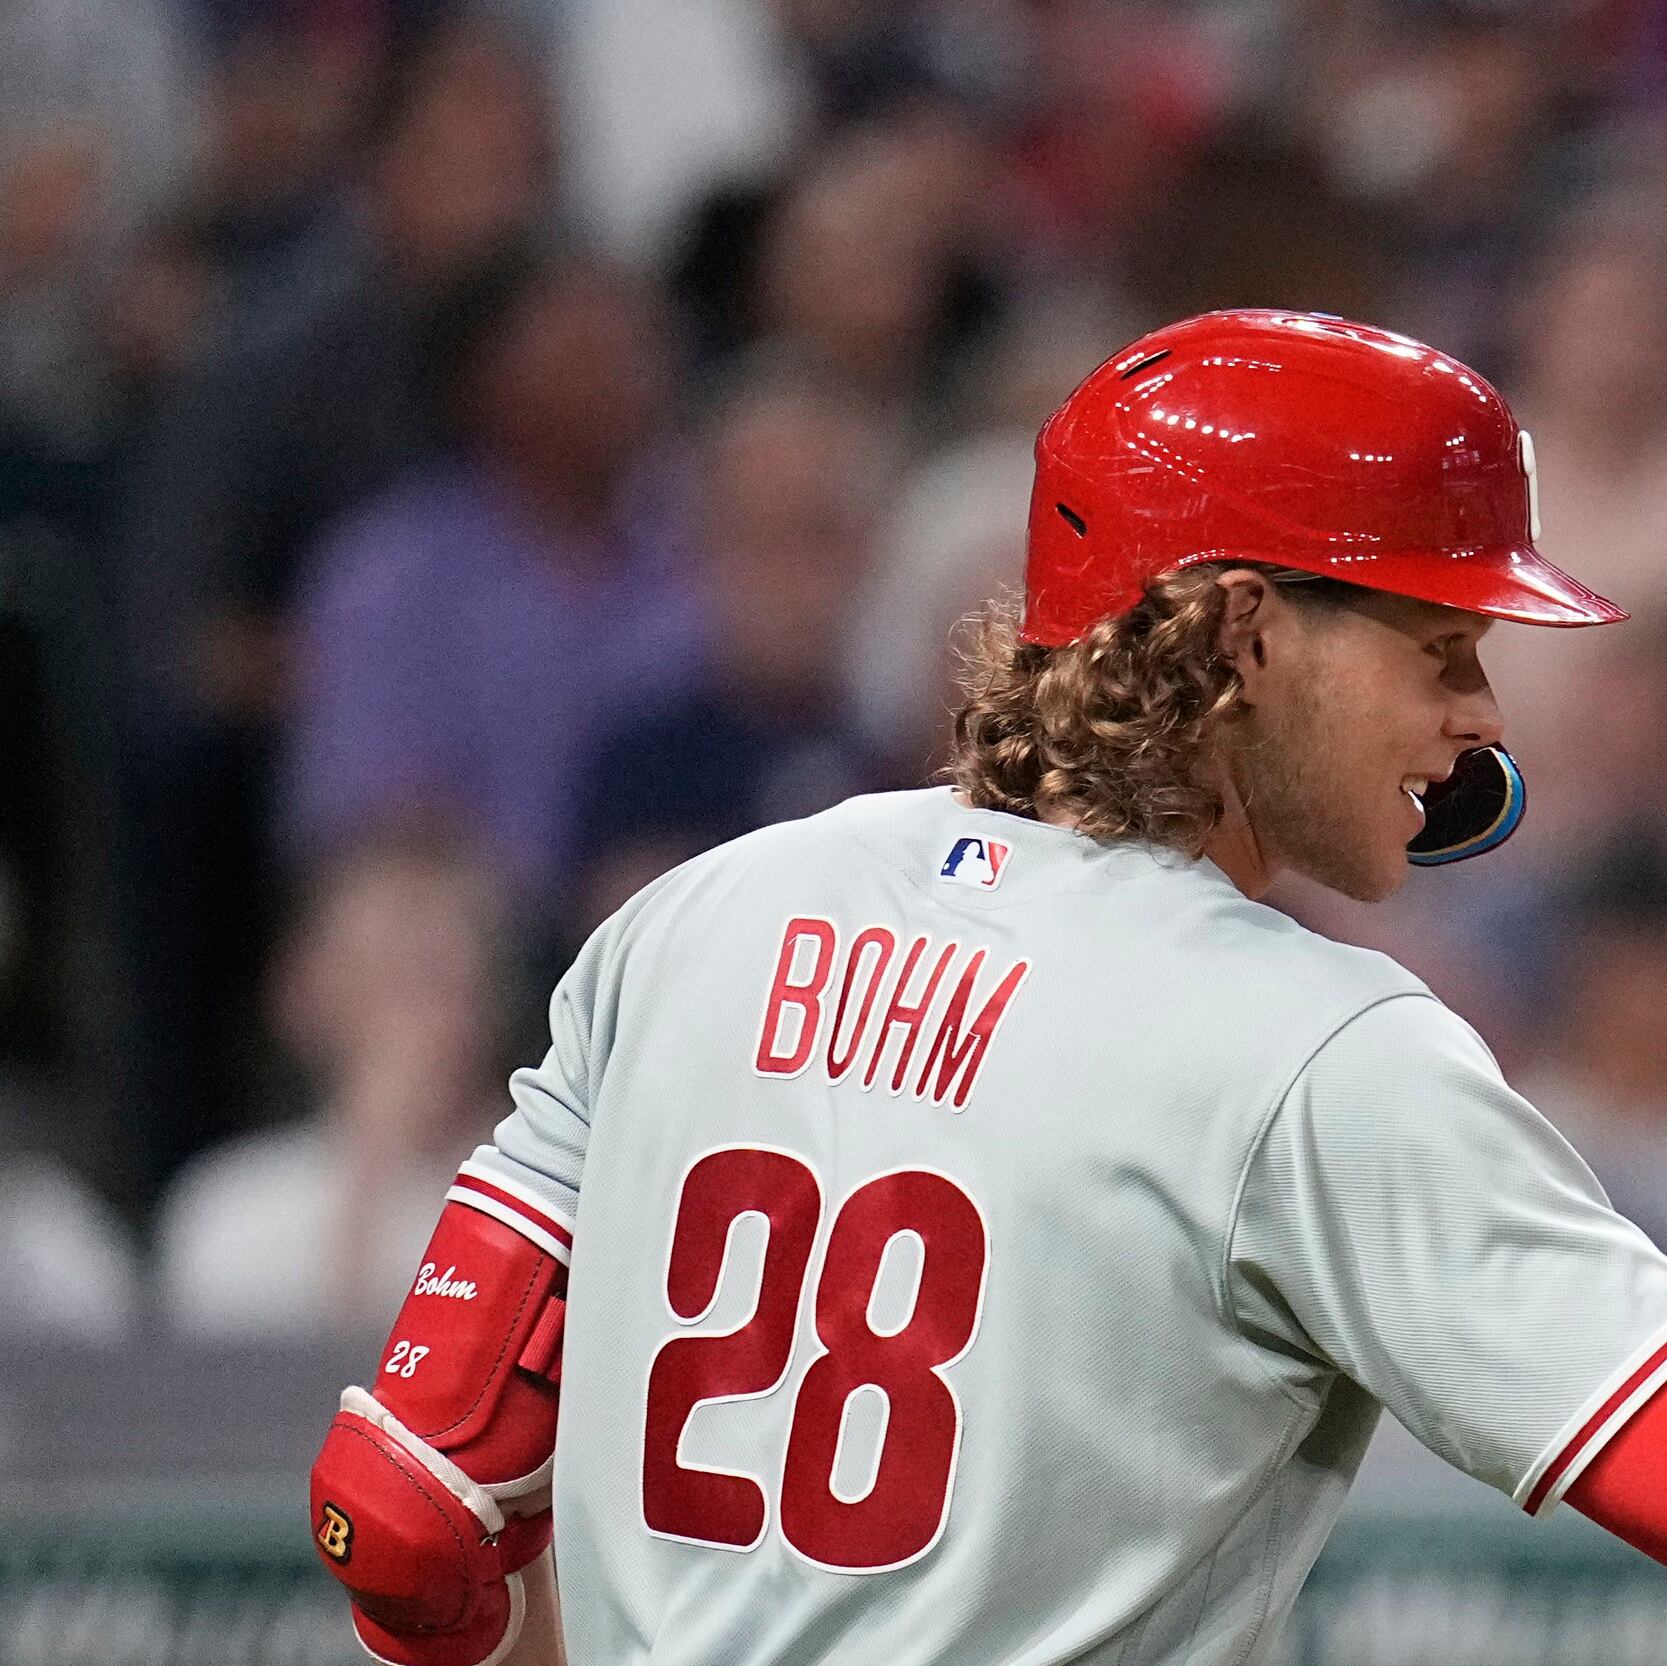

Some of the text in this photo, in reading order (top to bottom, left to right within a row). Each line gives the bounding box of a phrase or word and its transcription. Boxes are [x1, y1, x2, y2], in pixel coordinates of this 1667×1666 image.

[756, 914, 1031, 1112] BOHM
[414, 1262, 478, 1300] Bohm
[385, 1340, 431, 1378] 28
[642, 1141, 992, 1575] 28
